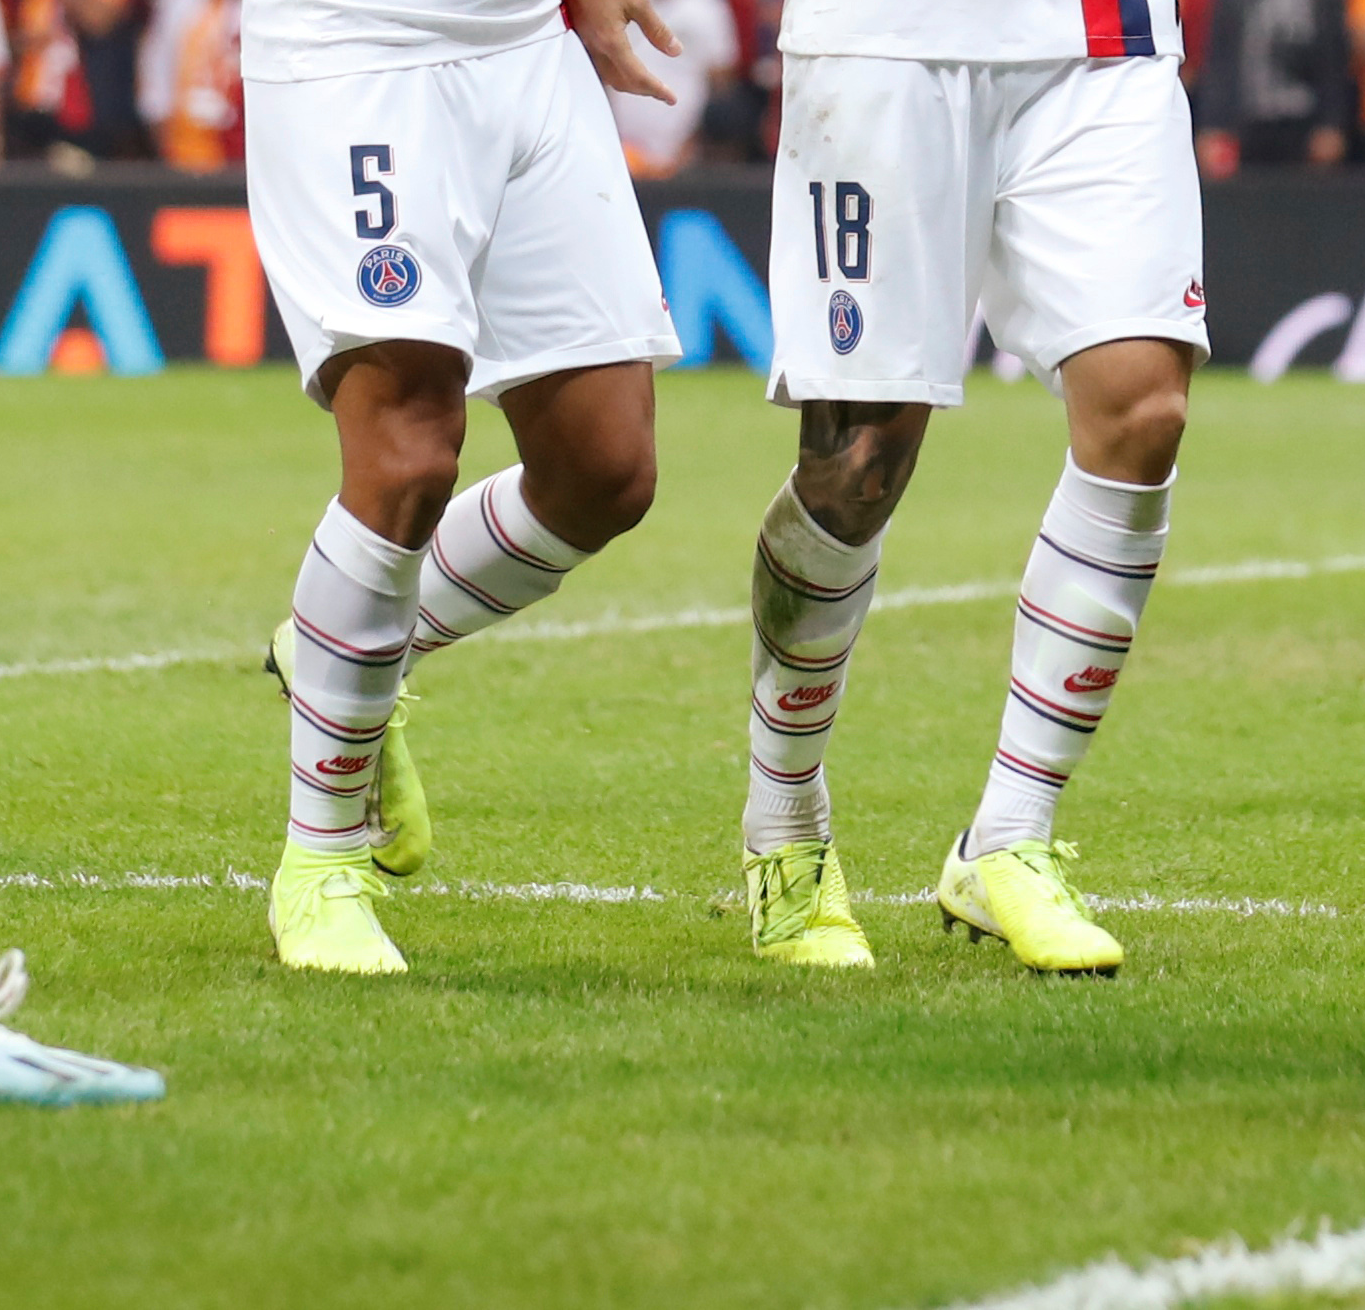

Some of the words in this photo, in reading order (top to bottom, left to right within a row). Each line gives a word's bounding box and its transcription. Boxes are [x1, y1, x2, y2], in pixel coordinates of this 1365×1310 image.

[350, 144, 395, 241] 5
[809, 181, 873, 282] 18
[364, 250, 405, 268] PARIS
